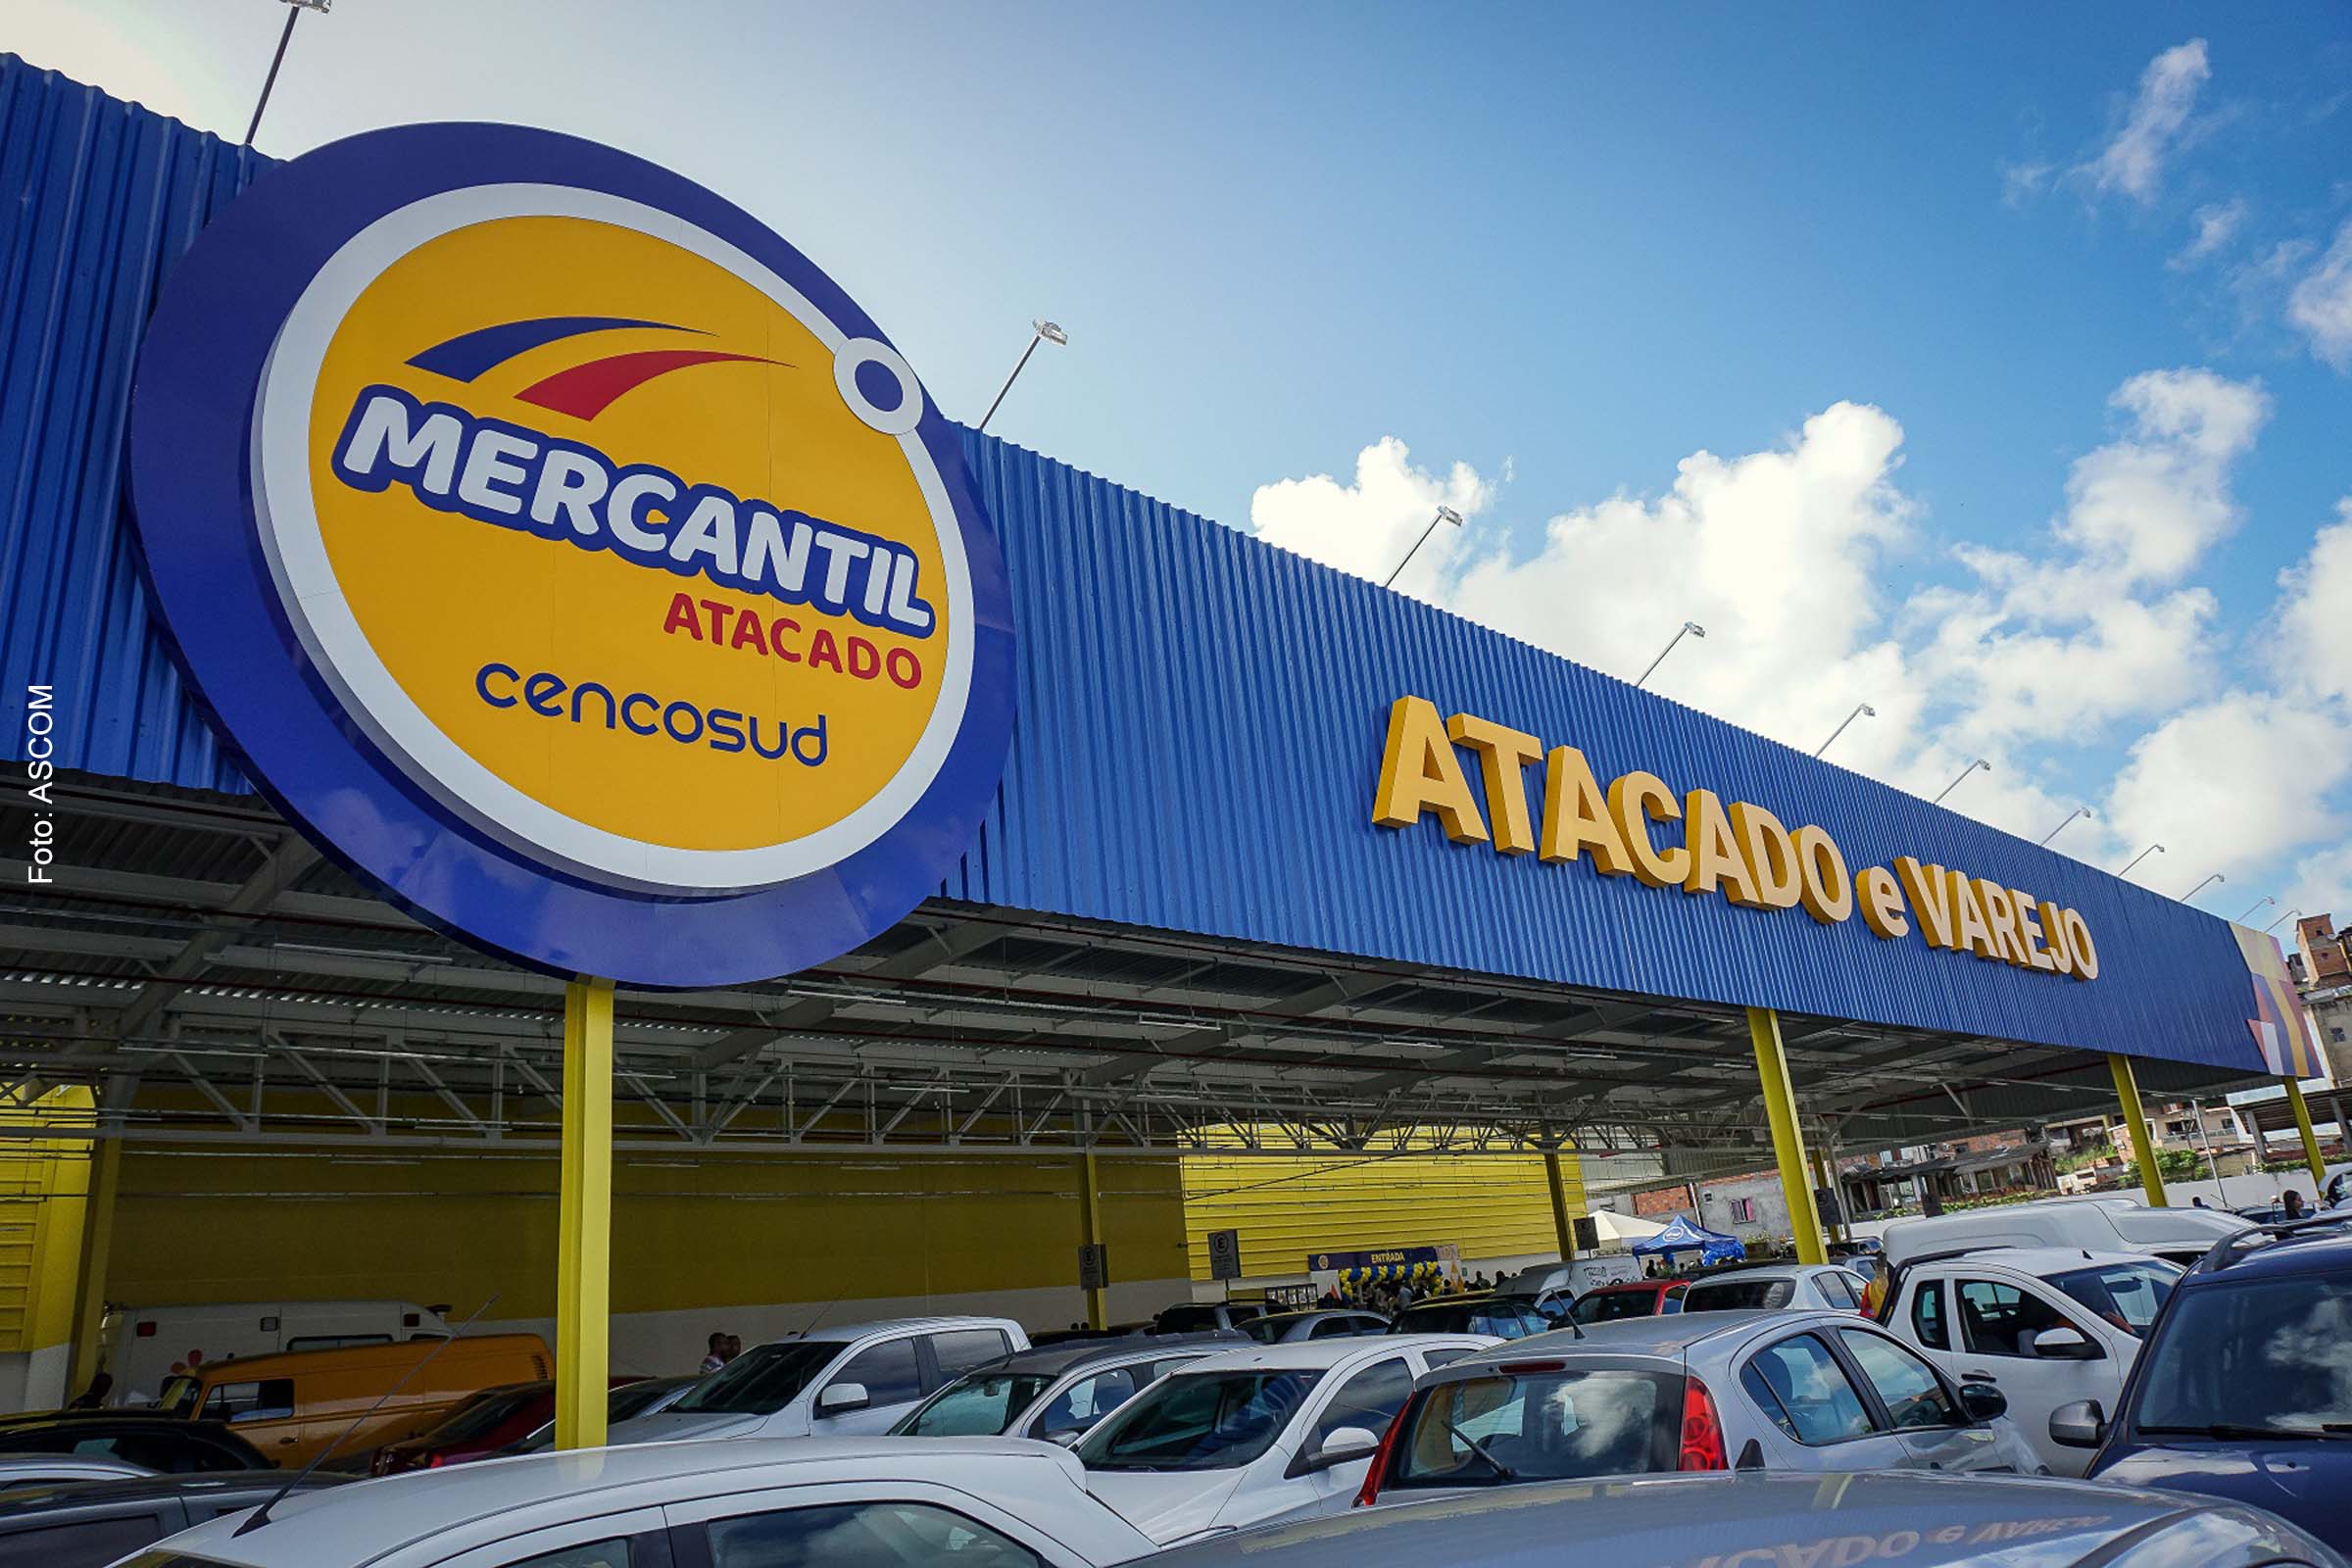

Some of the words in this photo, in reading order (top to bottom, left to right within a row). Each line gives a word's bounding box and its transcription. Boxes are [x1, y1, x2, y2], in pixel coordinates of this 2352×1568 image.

[339, 392, 932, 630] MERCANTIL
[662, 592, 922, 690] ATACADO
[475, 662, 829, 767] cencosud
[1372, 694, 1851, 924] ATACADO
[1855, 865, 1910, 940] e
[1893, 856, 2099, 982] VAREJO
[1371, 1250, 1405, 1264] ENTRADA
